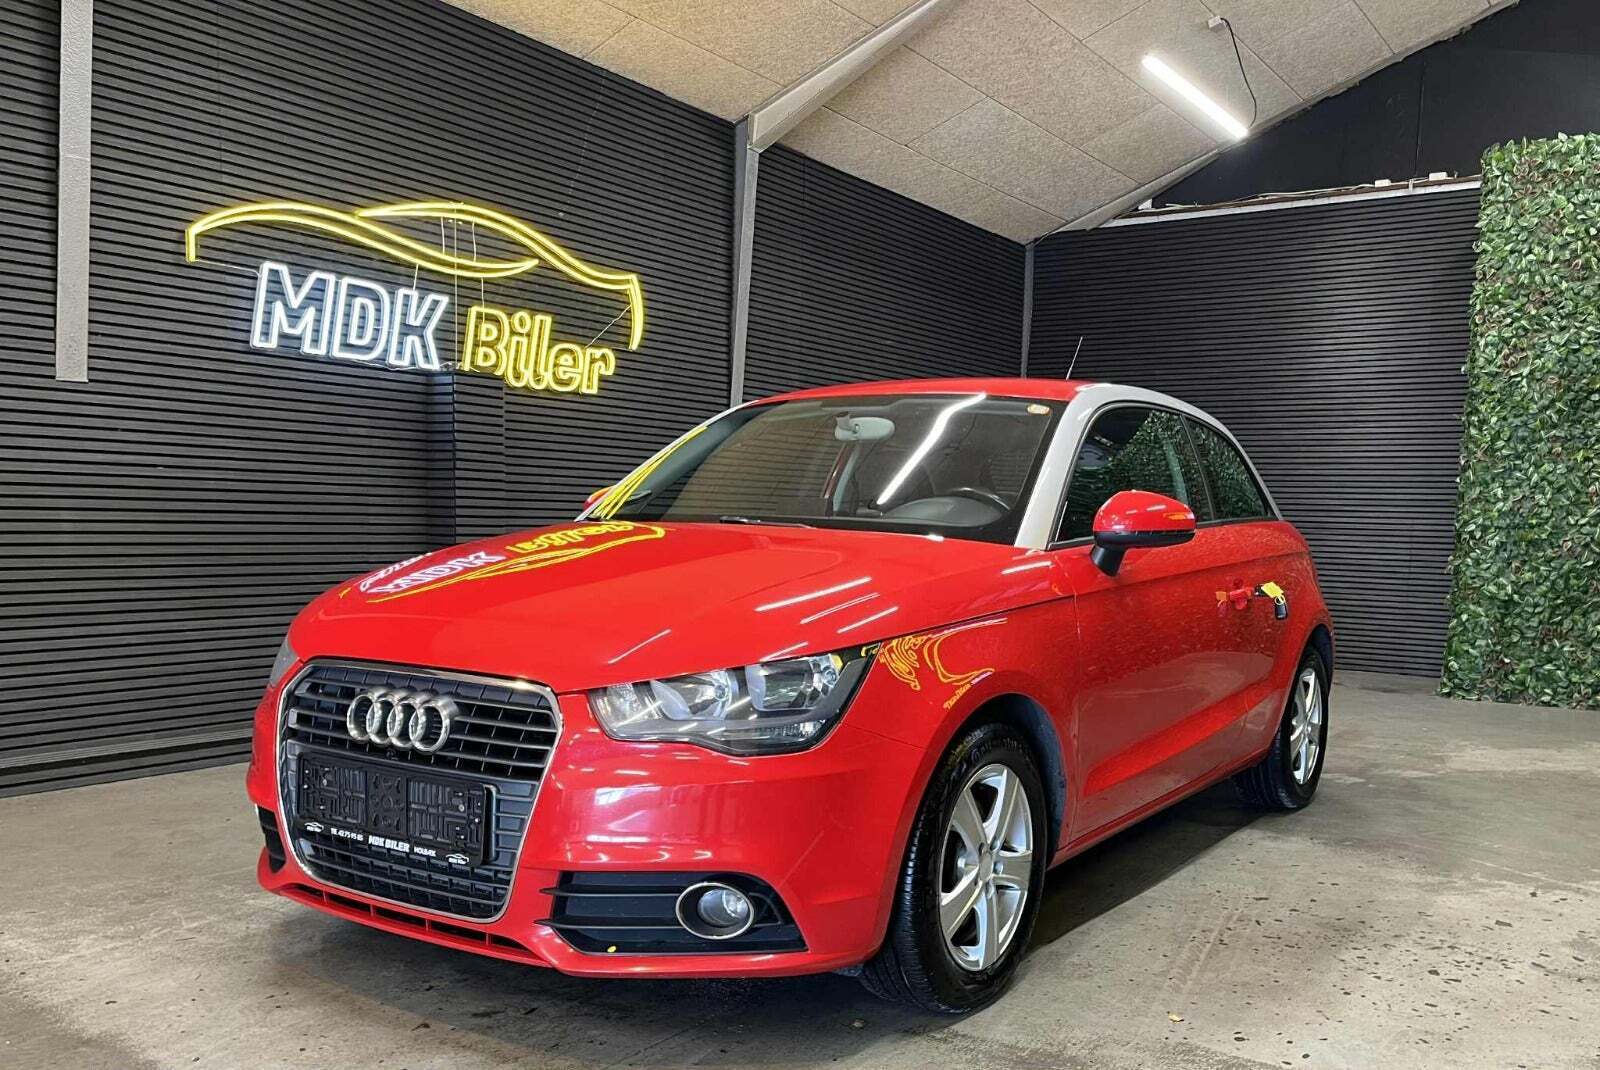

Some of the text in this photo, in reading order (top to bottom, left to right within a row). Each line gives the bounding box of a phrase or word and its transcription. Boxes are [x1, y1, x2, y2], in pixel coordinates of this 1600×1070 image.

[250, 261, 616, 395] MDK Biler
[385, 838, 410, 853] BILER
